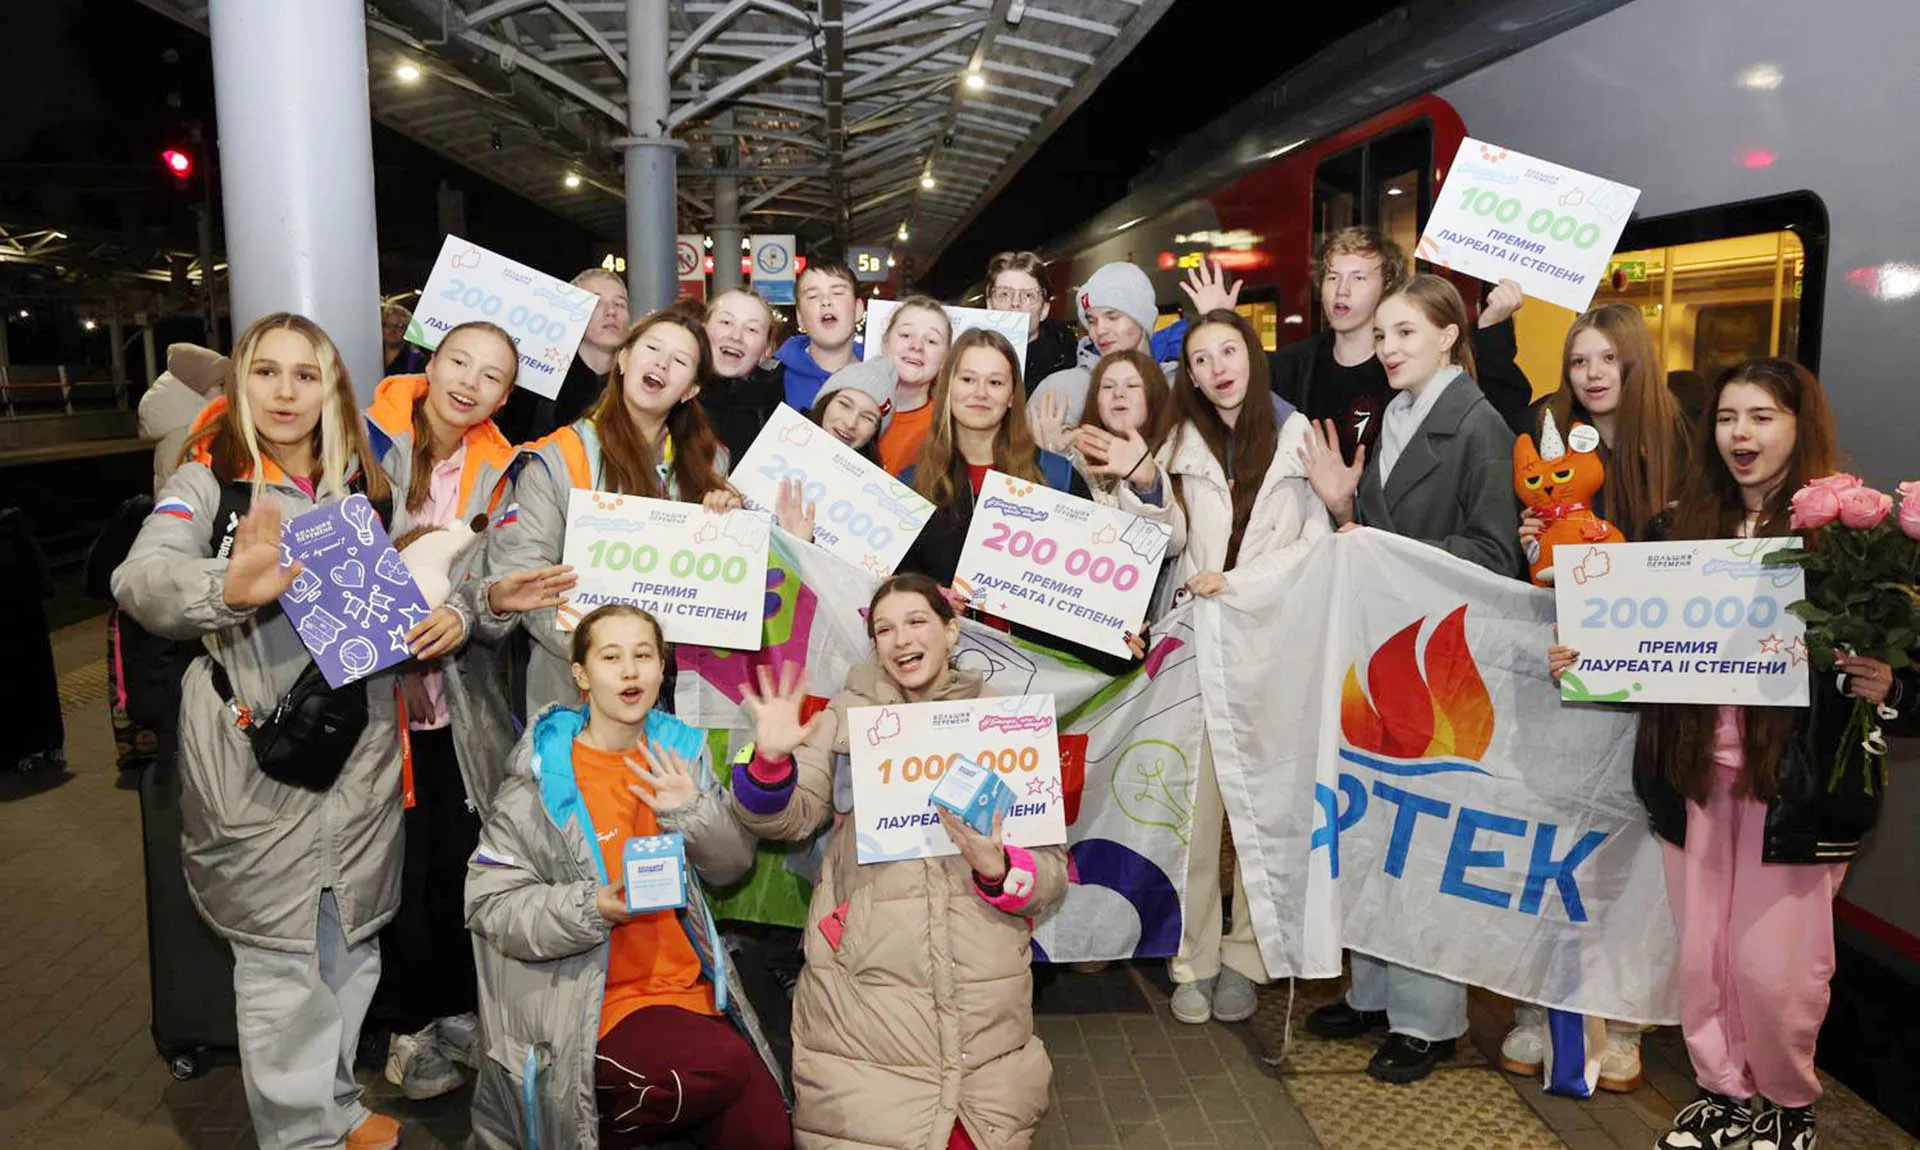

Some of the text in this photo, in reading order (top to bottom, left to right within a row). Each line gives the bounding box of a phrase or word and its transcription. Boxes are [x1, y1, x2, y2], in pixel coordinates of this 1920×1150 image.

[1460, 187, 1601, 249] 100 000
[1438, 229, 1507, 260] ЛАУРЕАТА
[1520, 255, 1586, 286] СТЕПЕНИ
[1487, 229, 1547, 255] ПРЕМИЯ
[424, 317, 452, 332] ЛАУ
[440, 279, 503, 316] 200
[508, 306, 567, 341] 000
[828, 499, 893, 550] 000
[587, 539, 748, 585] 100 000
[981, 522, 1139, 591] 200 000
[632, 582, 698, 599] ПРЕМИЯ
[1021, 570, 1084, 599] ПРЕМИЯ
[676, 604, 748, 622] СТЕПЕНИ
[971, 572, 1047, 605] ЛАУРЕАТА
[1056, 600, 1124, 630] СТЕПЕНИ
[1580, 595, 1778, 629] 200 000
[1638, 641, 1718, 654] ПРЕМИЯ
[1578, 659, 1787, 675] ЛАУРЕАТА II СТЕПЕНИ
[877, 758, 893, 784] 1
[876, 812, 940, 831] ЛАУРЕА
[1311, 773, 1609, 922] РТЕК
